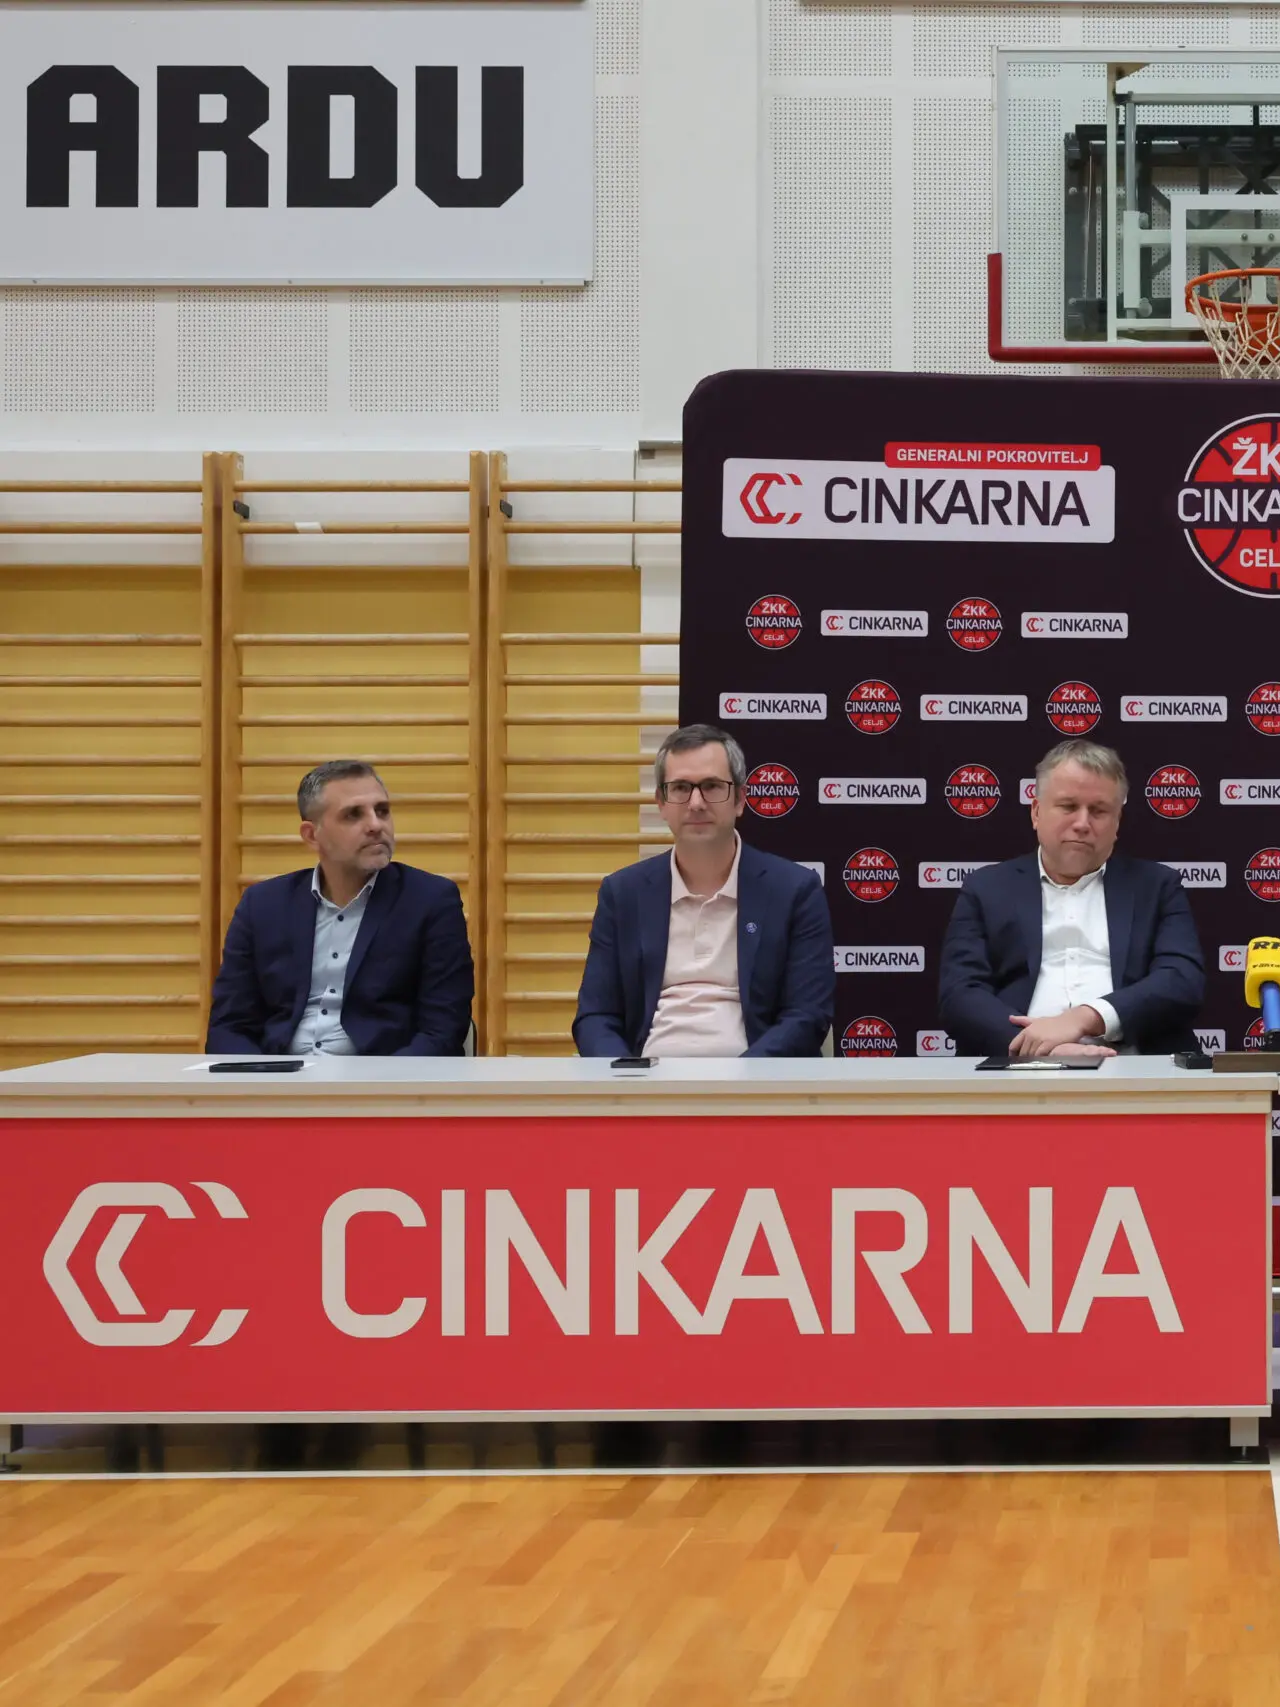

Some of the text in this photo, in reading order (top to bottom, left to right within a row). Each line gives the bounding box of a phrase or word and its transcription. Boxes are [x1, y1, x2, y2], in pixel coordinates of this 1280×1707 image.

[26, 65, 524, 208] ARDU
[896, 449, 1090, 465] GENERALNI POKROVITELJ
[824, 476, 1091, 527] CINKARNA
[848, 616, 924, 631] CINKARNA
[945, 618, 1004, 631] CINKARNA
[1049, 618, 1124, 633] CINKARNA
[747, 698, 822, 714] CINKARNA
[844, 701, 902, 713] CINKARNA
[948, 700, 1023, 715] CINKARNA
[1045, 702, 1103, 714] CINKARNA
[1148, 701, 1223, 716] CINKARNA
[846, 783, 922, 798] CINKARNA
[944, 785, 1002, 797] CINKARNA
[1144, 786, 1202, 798] CINKARNA
[842, 869, 900, 881] CINKARNA
[844, 951, 920, 967] CINKARNA
[840, 1038, 898, 1050] CINKARNA
[322, 1186, 1184, 1339] CINKARNA
